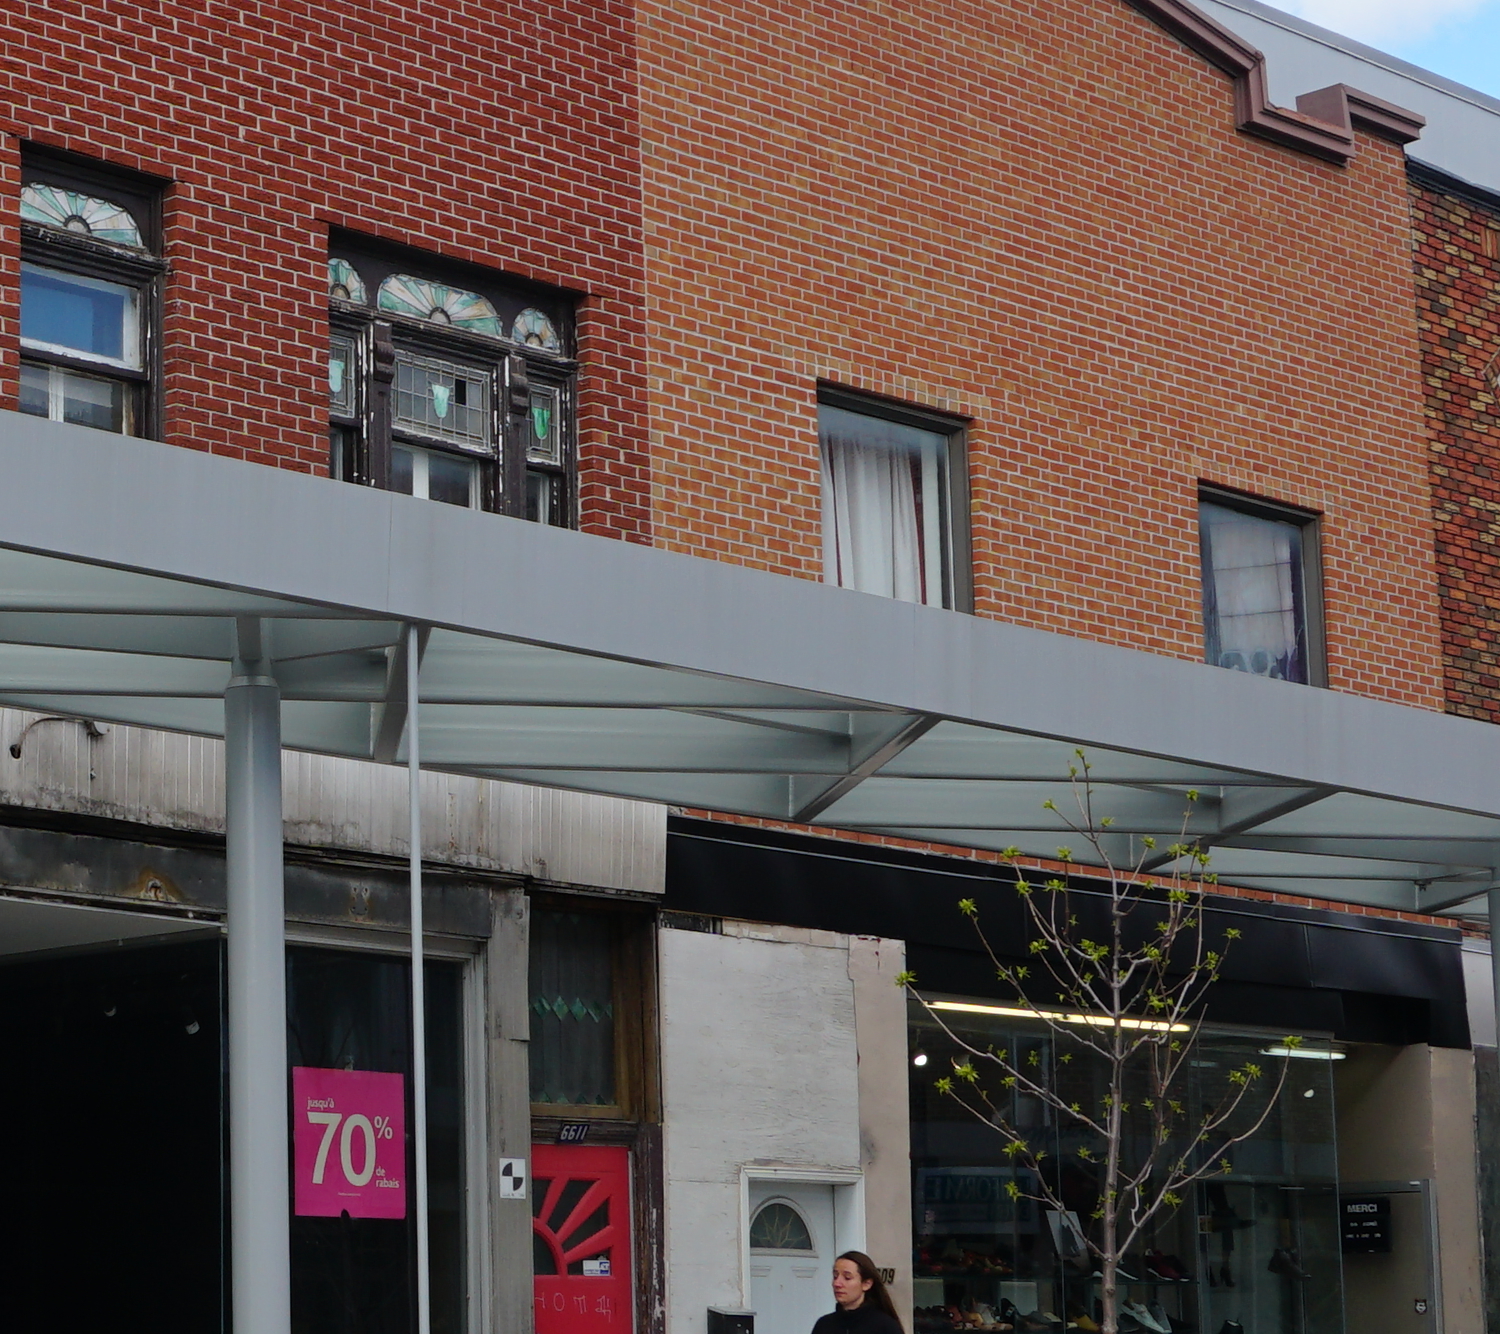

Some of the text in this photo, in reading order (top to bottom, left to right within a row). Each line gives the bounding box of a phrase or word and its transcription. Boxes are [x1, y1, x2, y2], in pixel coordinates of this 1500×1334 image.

[307, 1096, 335, 1110] jusqu'à
[560, 1125, 588, 1141] 6611
[375, 1166, 386, 1176] de
[375, 1178, 400, 1189] rabais
[1346, 1203, 1378, 1213] MERCI
